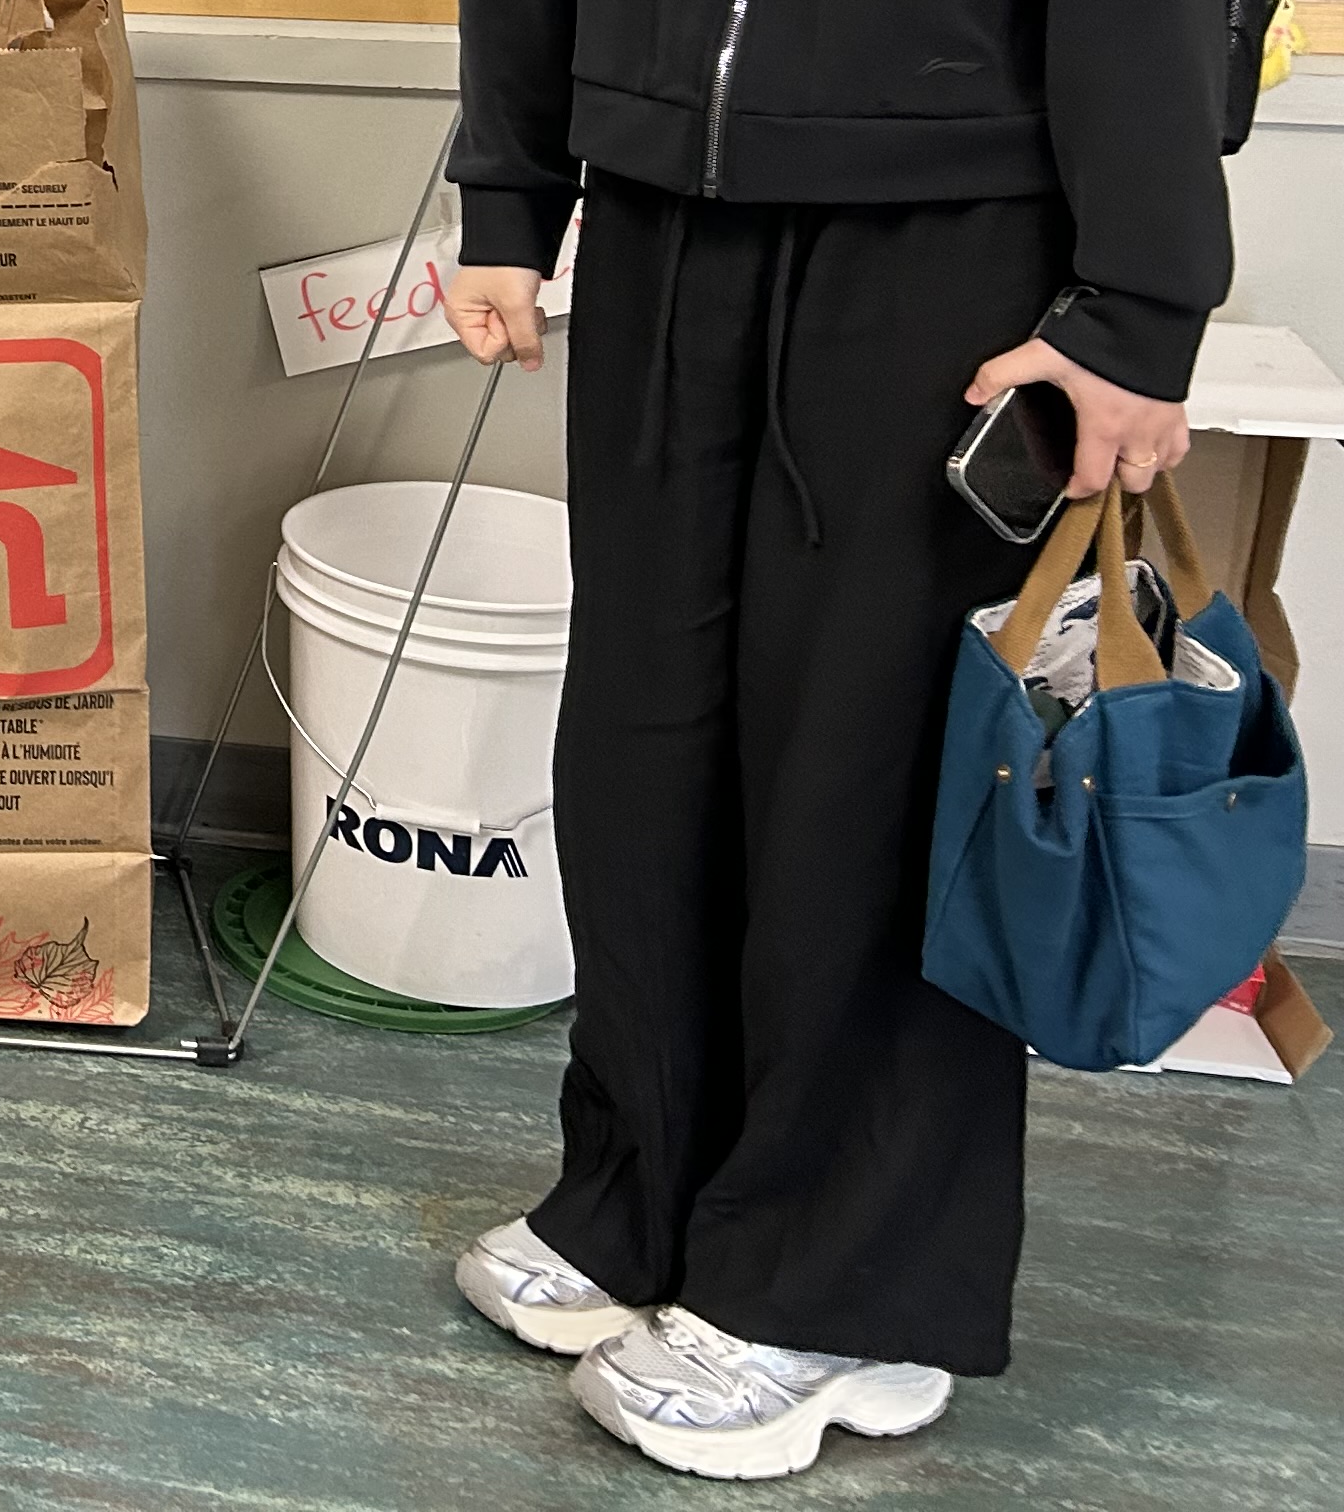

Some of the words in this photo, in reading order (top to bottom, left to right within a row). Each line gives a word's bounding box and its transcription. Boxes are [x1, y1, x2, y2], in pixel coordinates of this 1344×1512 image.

[21, 183, 68, 194] SECURELY
[36, 217, 47, 227] LE
[49, 217, 74, 227] HAUT
[76, 216, 90, 226] DU
[54, 696, 71, 710] DE
[1, 741, 10, 760] À
[9, 769, 57, 786] OUVERT
[326, 795, 529, 878] RONA
